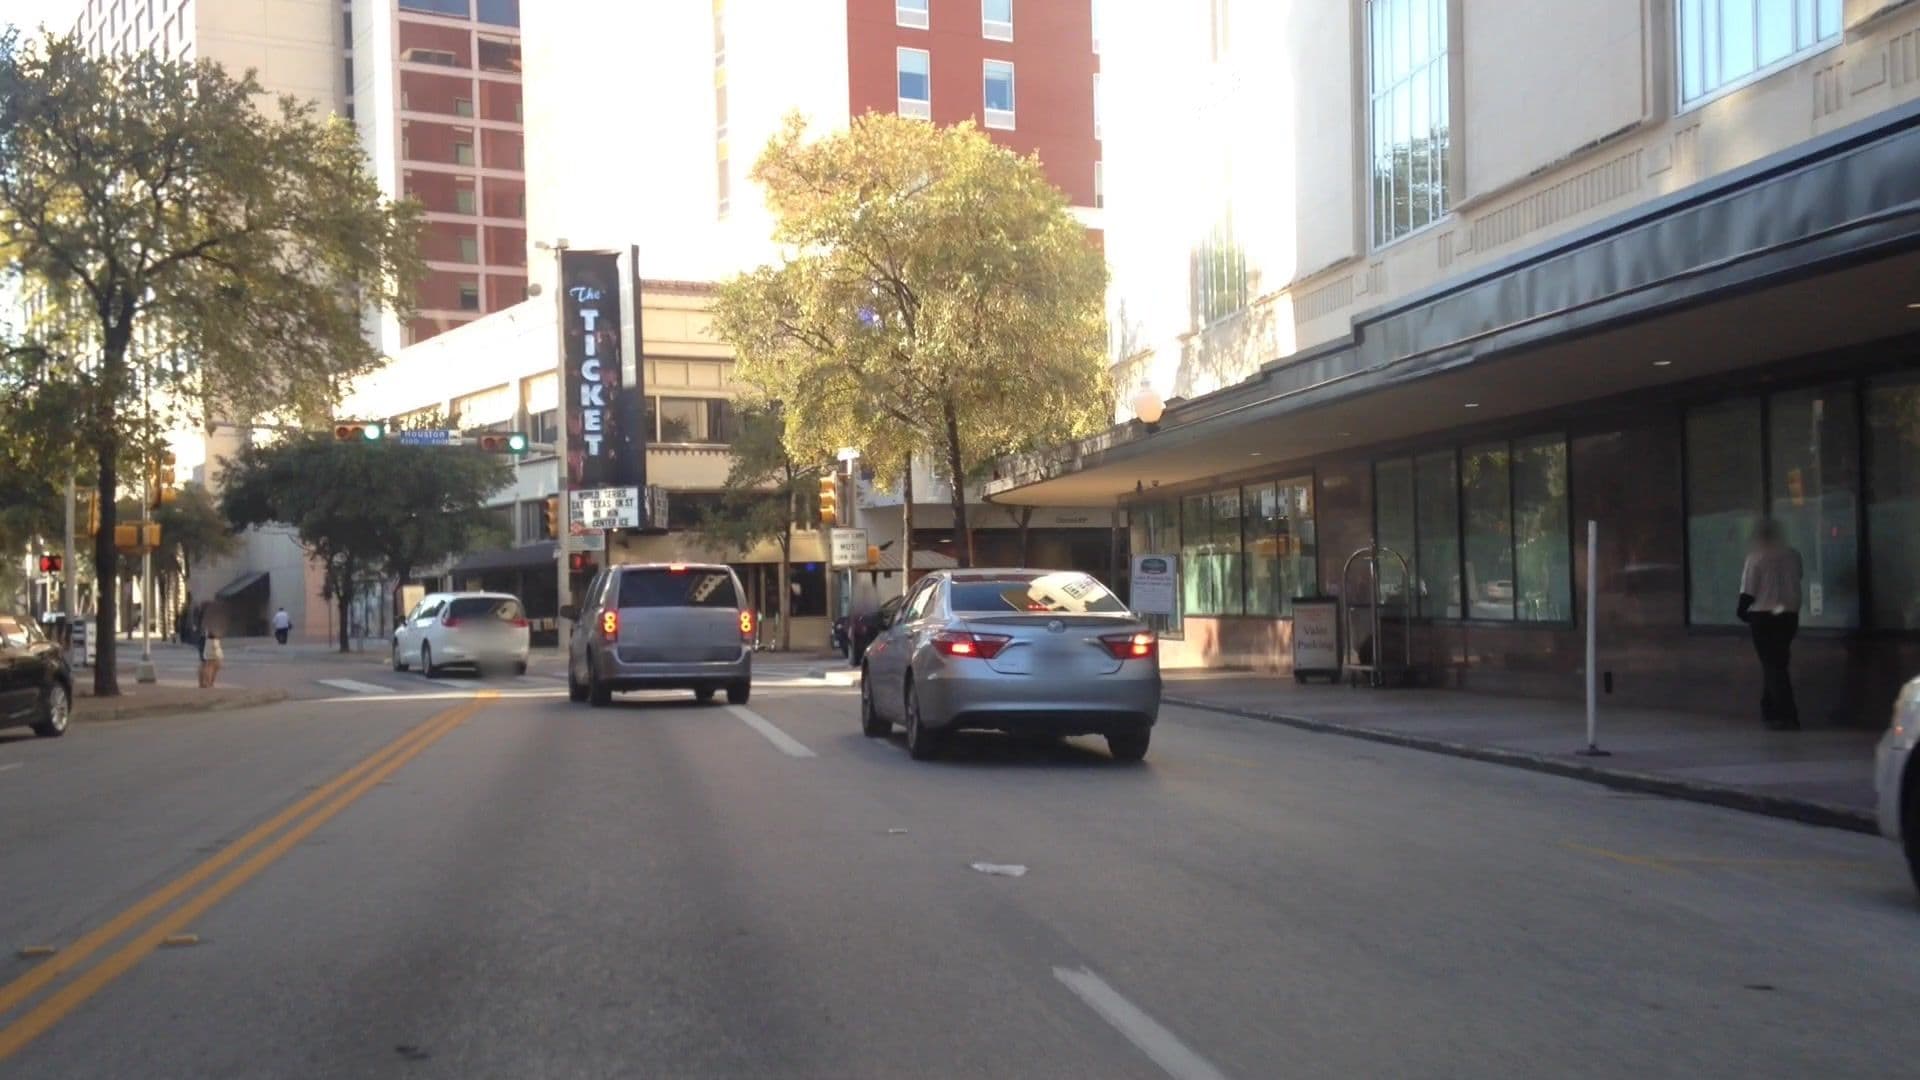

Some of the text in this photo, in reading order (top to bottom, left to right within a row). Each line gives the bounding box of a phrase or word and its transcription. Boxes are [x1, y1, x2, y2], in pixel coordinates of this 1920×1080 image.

[569, 287, 601, 302] The
[580, 309, 604, 455] TICKET
[404, 430, 445, 439] Houston
[590, 499, 611, 508] TEXAS
[625, 498, 633, 507] ST
[592, 518, 617, 527] CENTER
